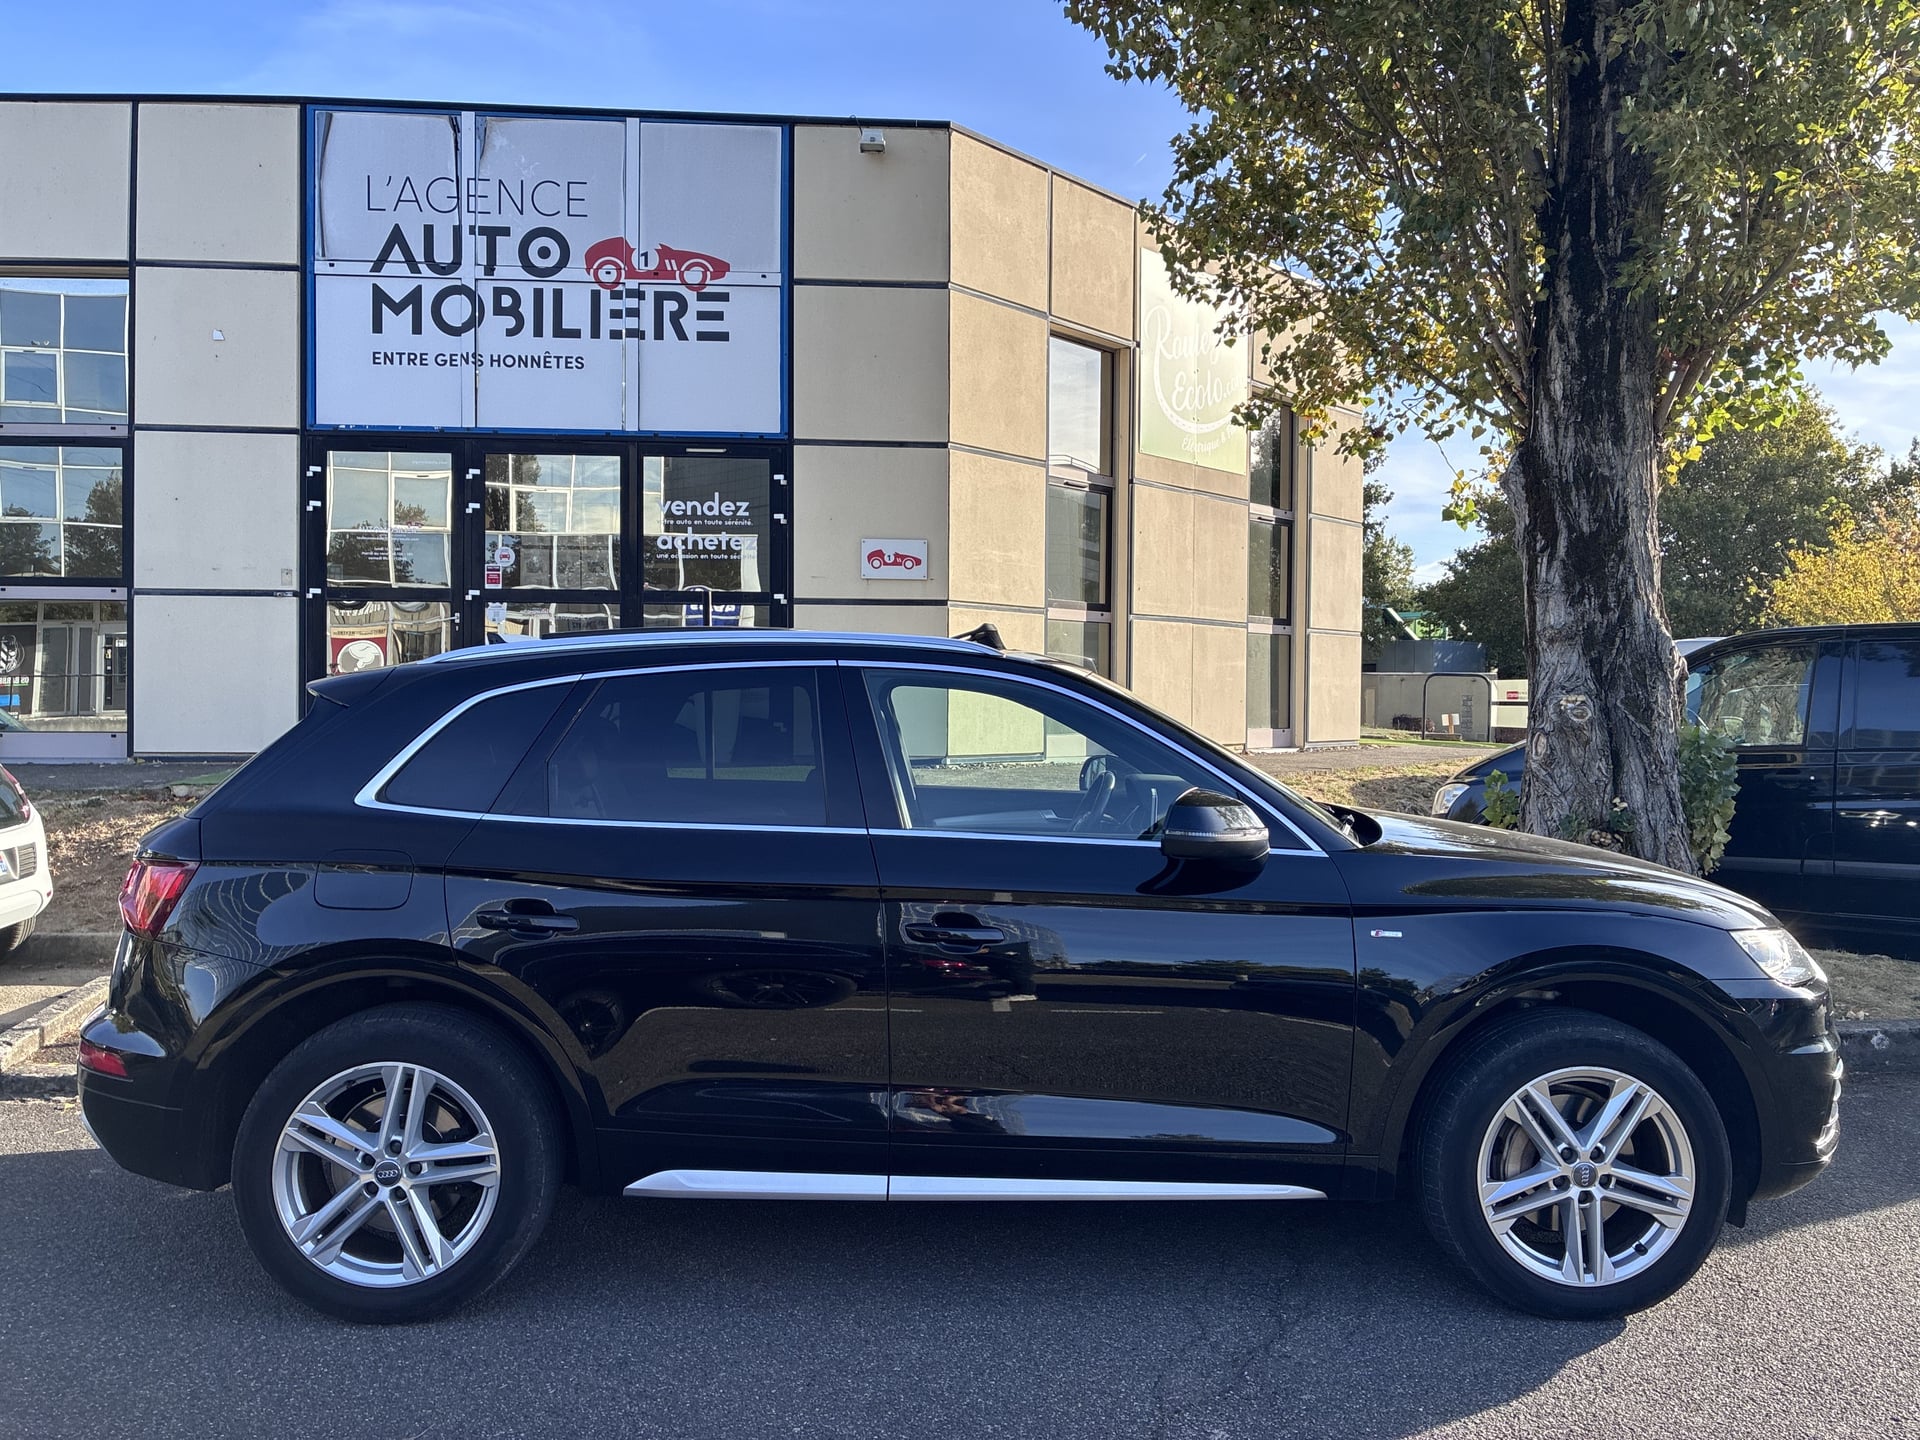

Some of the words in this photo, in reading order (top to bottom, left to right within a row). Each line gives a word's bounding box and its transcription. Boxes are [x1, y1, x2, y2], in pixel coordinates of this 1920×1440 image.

[367, 174, 589, 218] L'AGENCE
[369, 222, 571, 278] AUTO
[372, 351, 429, 367] ENTRE
[434, 352, 484, 368] GENS
[489, 350, 585, 369] HONNÊTES
[657, 492, 750, 517] vendez
[656, 526, 757, 551] achetez
